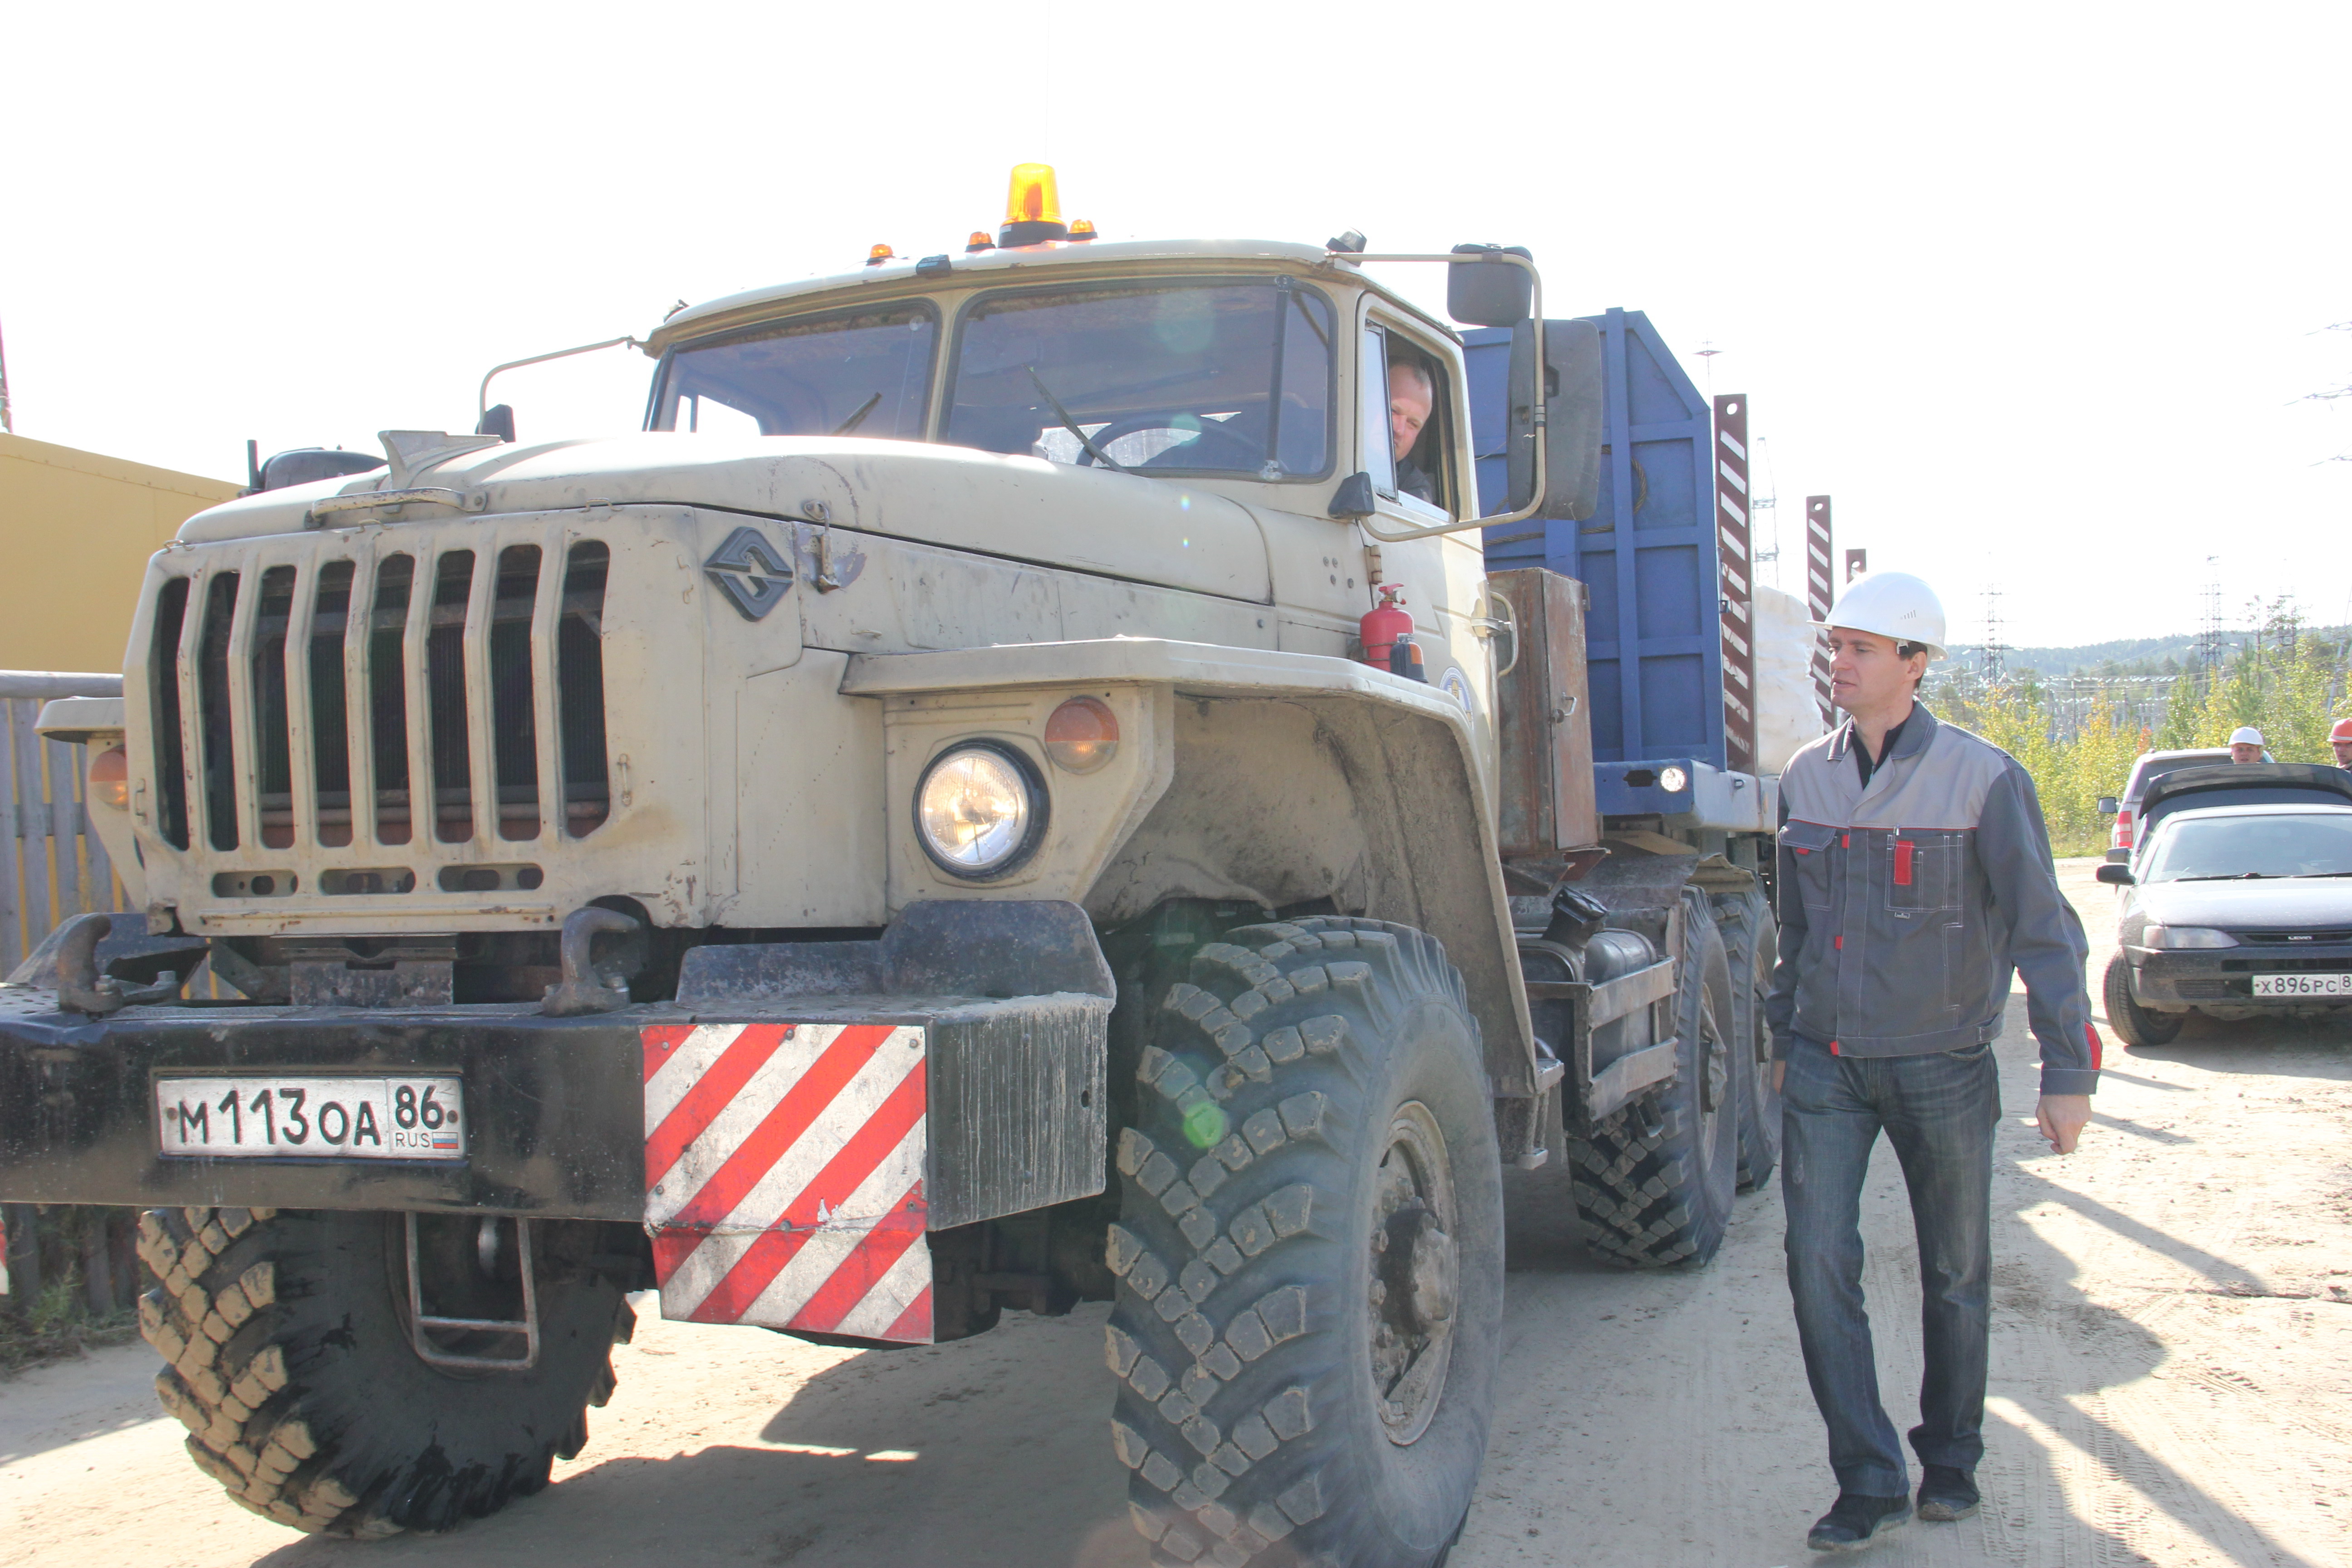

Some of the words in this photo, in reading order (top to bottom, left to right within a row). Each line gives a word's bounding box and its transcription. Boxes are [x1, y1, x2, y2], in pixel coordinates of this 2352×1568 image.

[2342, 975, 2351, 988] 8
[396, 1084, 445, 1130] 86
[395, 1132, 431, 1148] RUS
